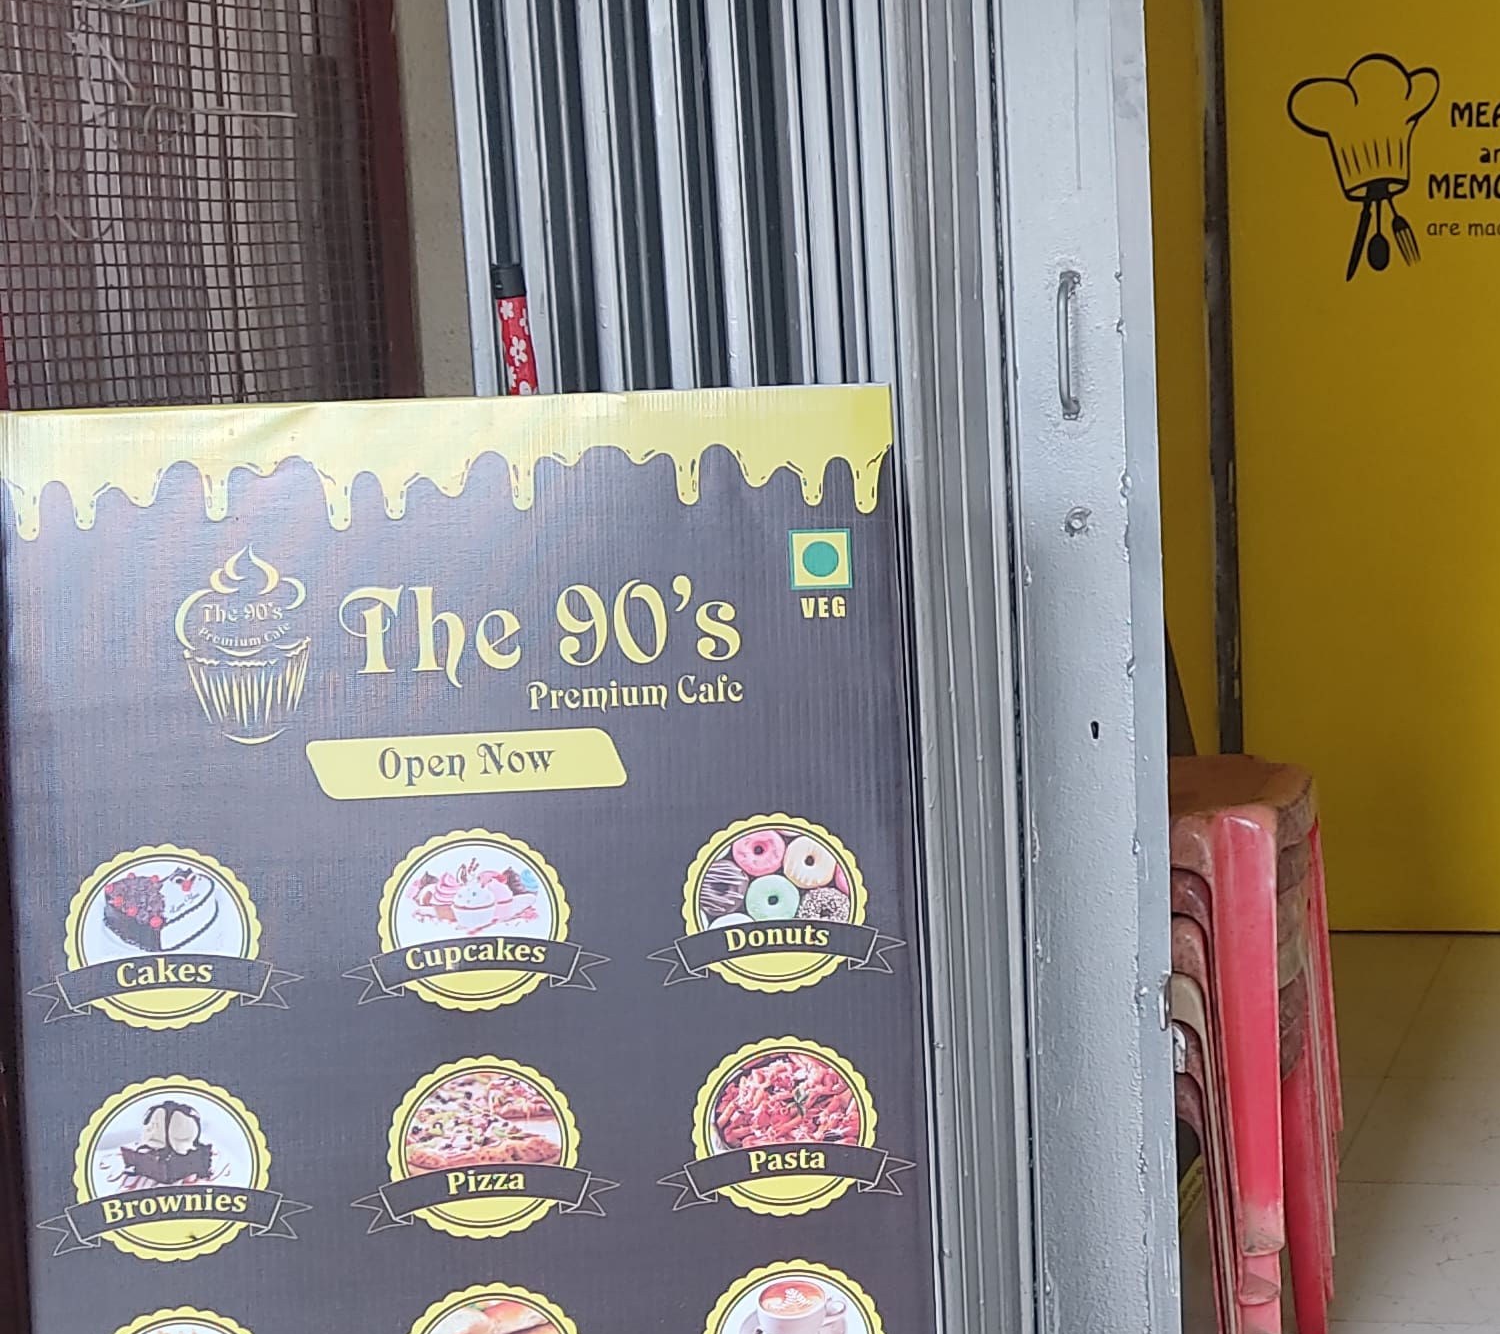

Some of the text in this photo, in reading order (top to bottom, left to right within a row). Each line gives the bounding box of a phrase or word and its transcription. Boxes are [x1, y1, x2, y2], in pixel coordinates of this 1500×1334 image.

[1427, 220, 1460, 236] are
[201, 604, 238, 624] The
[800, 595, 846, 619] VEG
[199, 622, 292, 647] Premium Cafe
[339, 584, 522, 688] The
[527, 674, 744, 713] Premium Cafe
[378, 742, 555, 787] Open Now
[723, 923, 831, 954] Donuts
[404, 939, 548, 974] Cupcakes
[115, 957, 214, 989] Cakes
[748, 1145, 827, 1175] Pasta
[446, 1168, 528, 1197] Pizza
[101, 1188, 249, 1225] Brownies
